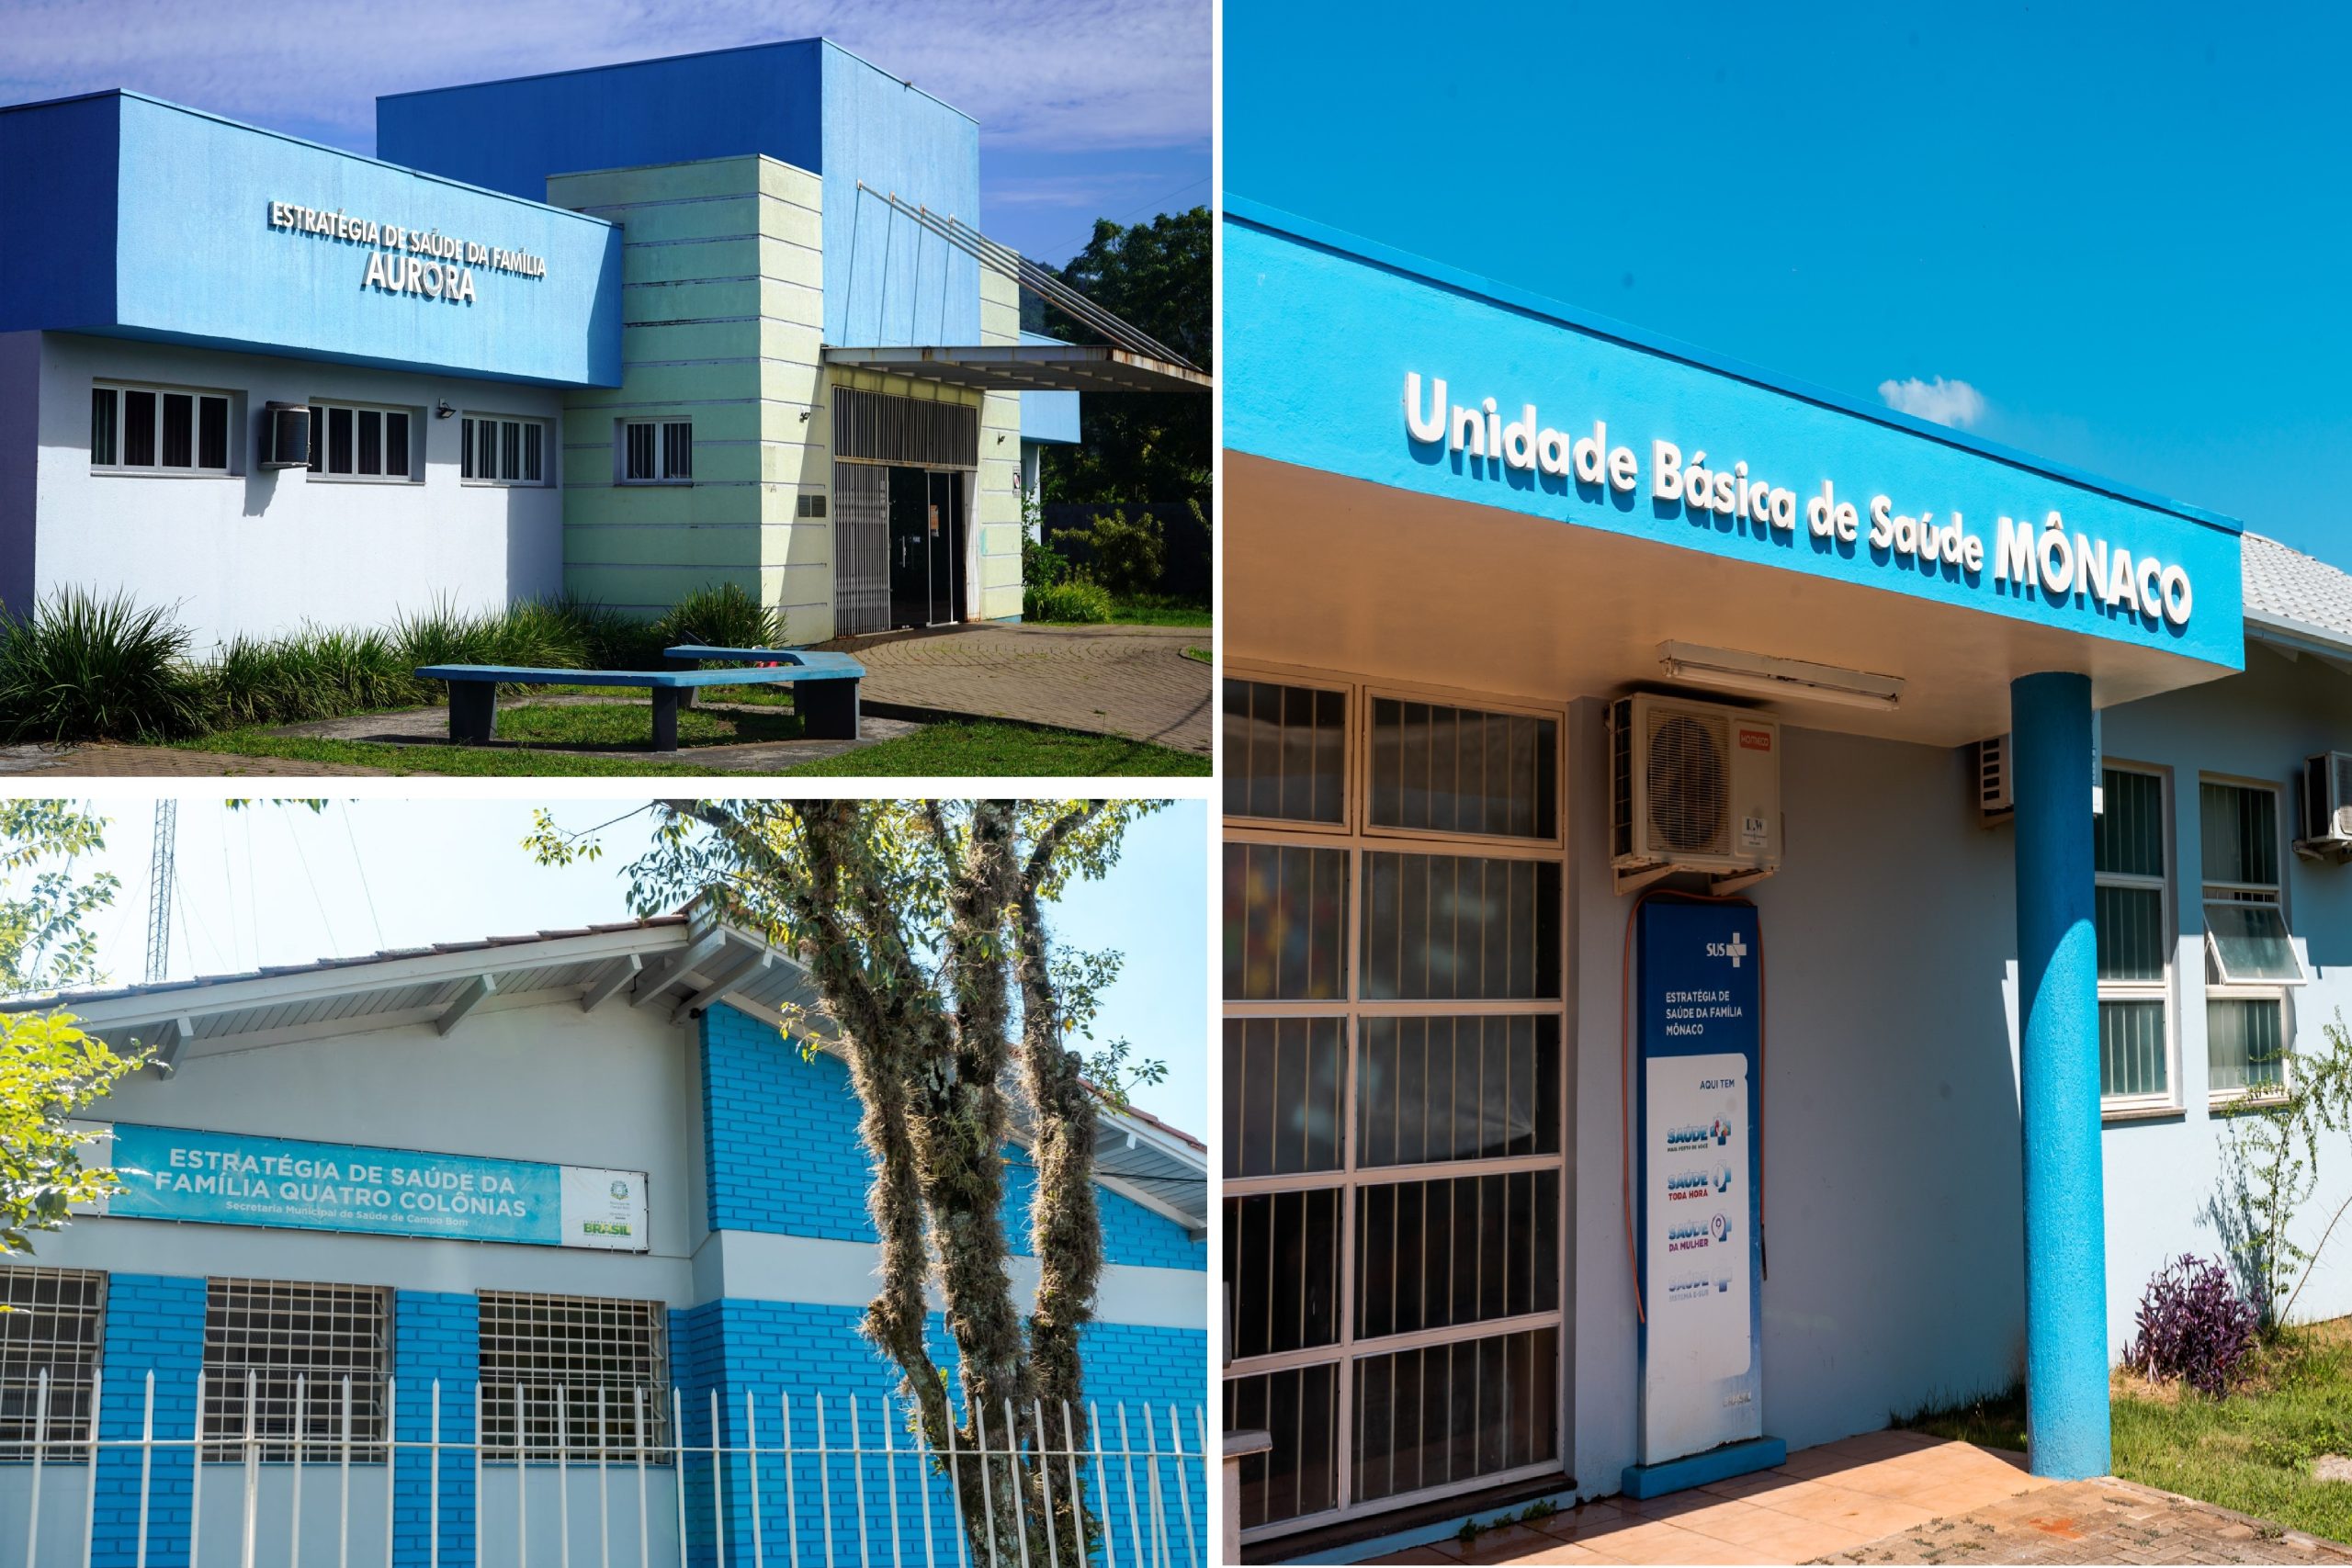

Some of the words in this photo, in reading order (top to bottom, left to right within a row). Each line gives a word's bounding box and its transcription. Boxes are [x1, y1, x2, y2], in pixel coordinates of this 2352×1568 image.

[268, 200, 379, 243] ESTRATÉGIA
[382, 225, 406, 249] DE
[408, 229, 463, 261] SAÚDE
[465, 242, 487, 265] DA
[490, 248, 546, 276] FAMÍLIA
[362, 251, 476, 302] AURORA
[1403, 371, 1638, 492] Unidade
[1652, 439, 1796, 530] Básica
[1808, 479, 1859, 543] de
[1869, 495, 1983, 572] Saúde
[1995, 511, 2193, 626] MÔNACO
[1706, 942, 1725, 957] SUS
[1666, 989, 1717, 1003] ESTRATÉGIA
[1718, 990, 1730, 1001] DE
[1666, 1006, 1694, 1020] SAÚDE
[1696, 1009, 1709, 1019] DA
[1710, 1005, 1743, 1018] FAMÍLIA
[1666, 1022, 1704, 1036] MÔNACO
[1700, 1079, 1719, 1089] AQUI
[1720, 1078, 1736, 1089] TEM
[1667, 1123, 1708, 1145] SAÚDE
[170, 1148, 340, 1180] ESTRATÉGIA
[349, 1164, 383, 1184] DE
[391, 1166, 474, 1191] SAÚDE
[481, 1176, 515, 1194] DA
[1668, 1168, 1708, 1190] SAÚDE
[155, 1171, 270, 1199] FAMÍLIA
[279, 1181, 390, 1208] QUATRO
[400, 1192, 526, 1217] COLÔNIAS
[1668, 1191, 1687, 1201] TODA
[1689, 1189, 1708, 1199] HORA
[226, 1201, 282, 1213] Secretaria
[286, 1205, 336, 1218] Municipal
[340, 1209, 353, 1219] de
[356, 1211, 389, 1222] Saúde
[391, 1213, 404, 1223] de
[407, 1214, 443, 1226] Campo
[446, 1217, 469, 1227] Bom
[583, 1223, 631, 1236] BRASIL
[1668, 1218, 1709, 1240] SAÚDE
[1668, 1242, 1679, 1252] DA
[1679, 1238, 1709, 1250] MULHER
